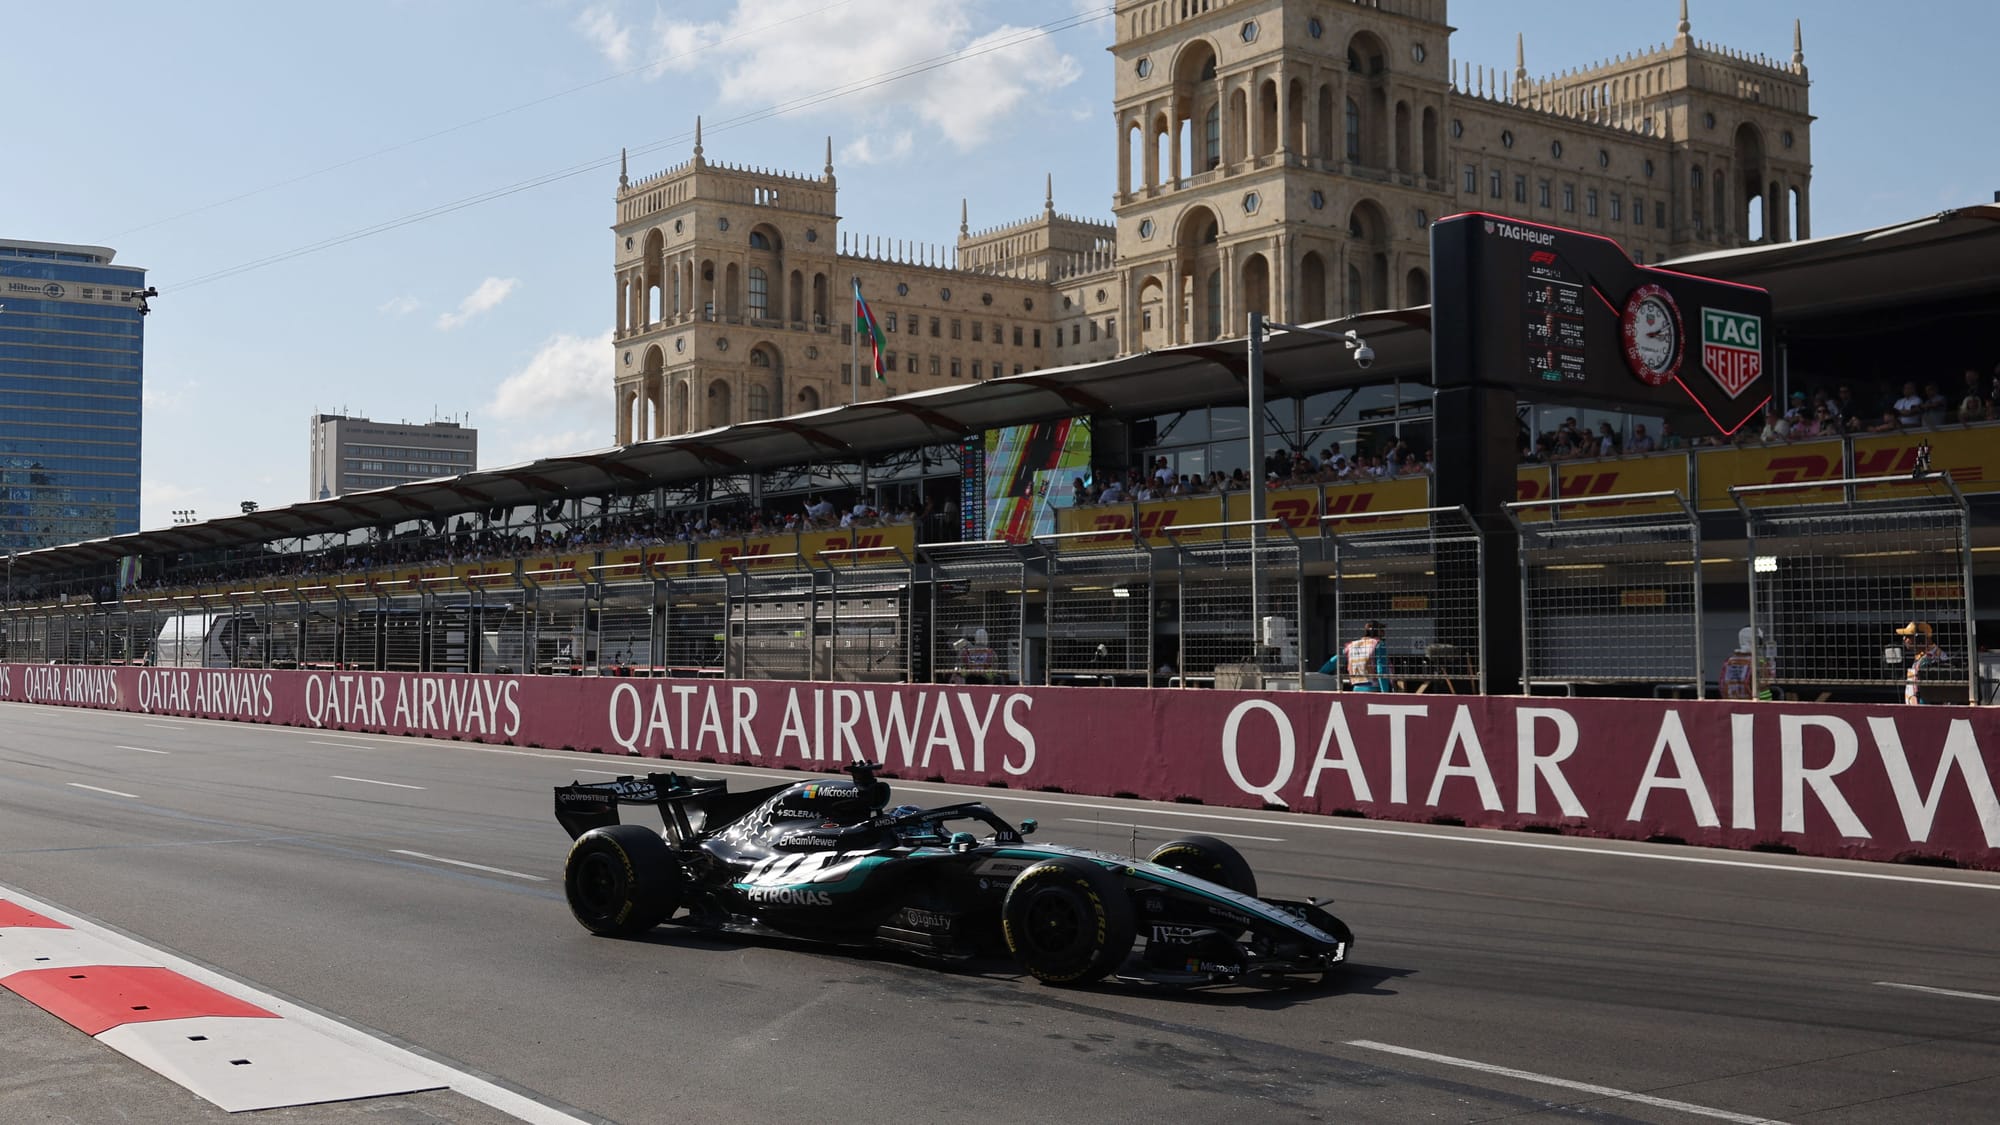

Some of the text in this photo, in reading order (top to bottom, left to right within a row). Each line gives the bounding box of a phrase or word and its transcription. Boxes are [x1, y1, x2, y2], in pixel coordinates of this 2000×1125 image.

[8, 282, 41, 293] Hilton
[1706, 315, 1758, 346] TAG
[1706, 345, 1760, 388] HEUER
[1765, 446, 1934, 495] DHL
[1265, 492, 1378, 531] DHL
[1092, 509, 1182, 543] DHL
[716, 543, 773, 567] DHL
[821, 534, 890, 559] DHL
[620, 552, 667, 575] DHL
[25, 667, 61, 702] QATAR
[64, 668, 117, 705] AIRWAYS
[138, 670, 272, 718] QATAR AIRWAYS
[306, 674, 520, 737] QATAR AIRWAYS
[609, 683, 1036, 776] QATAR AIRWAYS
[1222, 698, 1590, 819] QATAR
[561, 793, 609, 803] CROWDSTRIKE
[818, 785, 859, 799] Microsoft
[783, 808, 814, 819] SOLERA
[788, 836, 837, 848] TeamViewer
[748, 887, 833, 906] PETRONAS
[907, 910, 951, 931] Signify
[1088, 892, 1105, 945] ZERO
[1152, 925, 1193, 944] IWC
[1200, 961, 1241, 975] Microsoft
